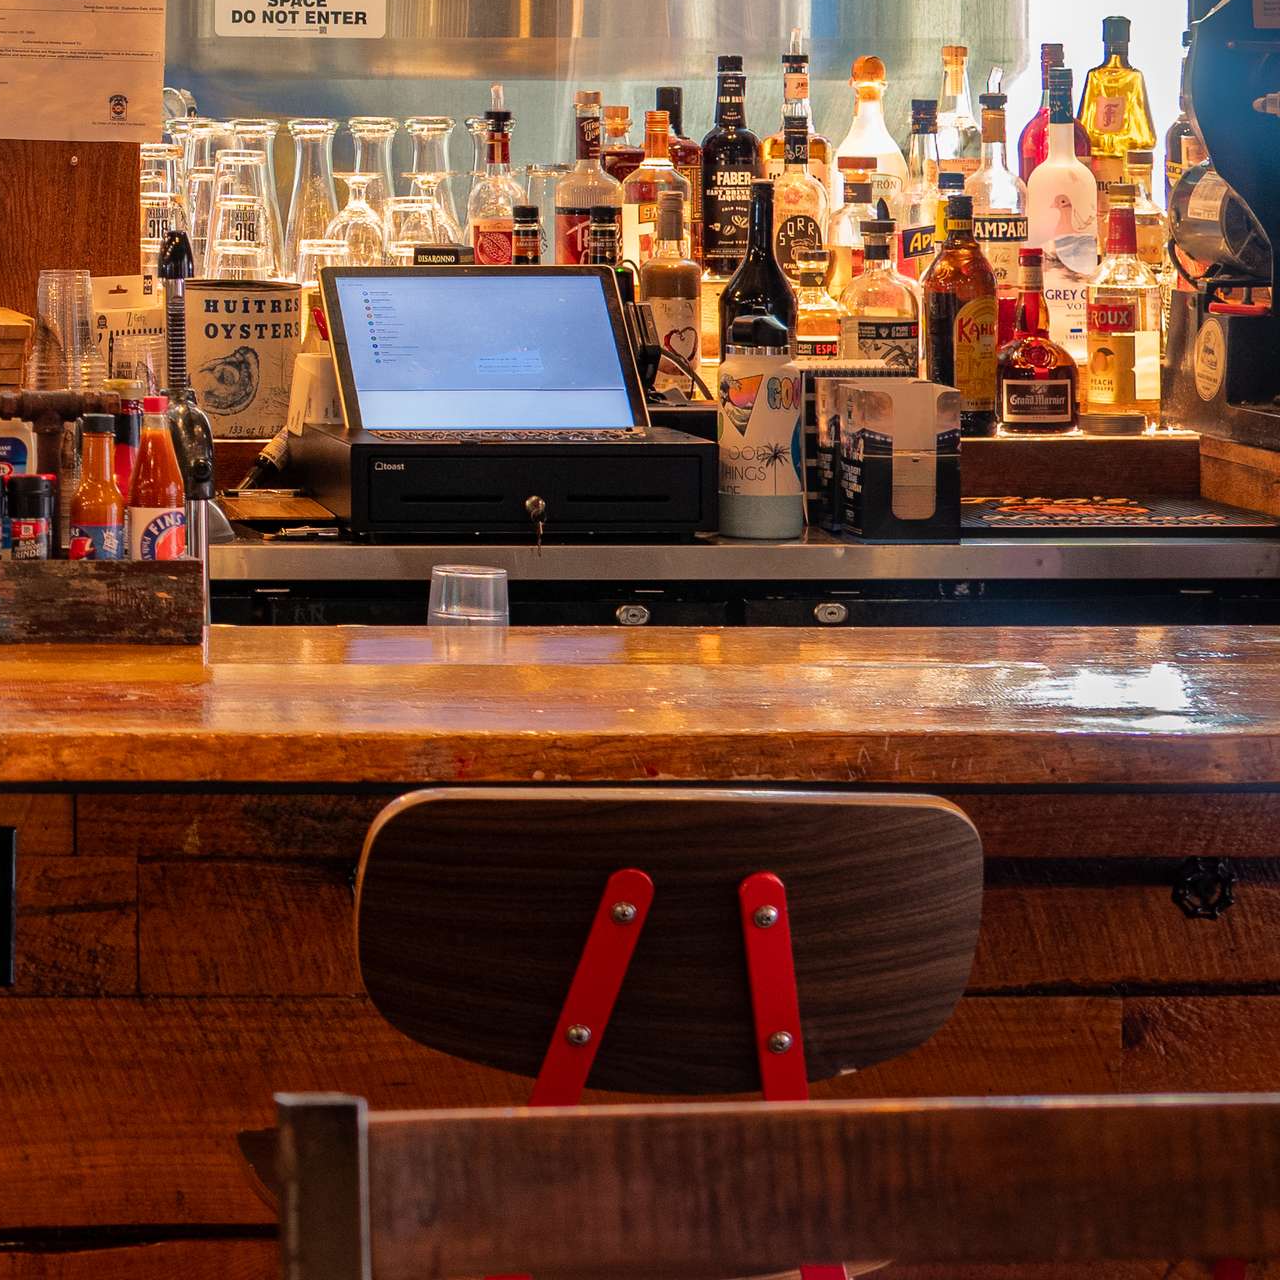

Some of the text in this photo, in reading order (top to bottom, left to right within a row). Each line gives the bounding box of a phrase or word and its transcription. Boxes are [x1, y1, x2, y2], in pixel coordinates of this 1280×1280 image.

[232, 10, 367, 25] DO NOT ENTER
[717, 172, 751, 186] FABER
[974, 221, 1027, 238] AMPARI
[418, 254, 455, 263] DISARONNO
[1045, 289, 1078, 301] GREY
[204, 297, 299, 314] HUÎTRES
[204, 323, 299, 340] OYSTERS
[816, 344, 838, 354] ESPO
[1010, 395, 1034, 405] Grand
[728, 445, 766, 461] OOD
[384, 462, 404, 470] toast
[724, 466, 767, 481] HINGS
[148, 512, 184, 535] FINS
